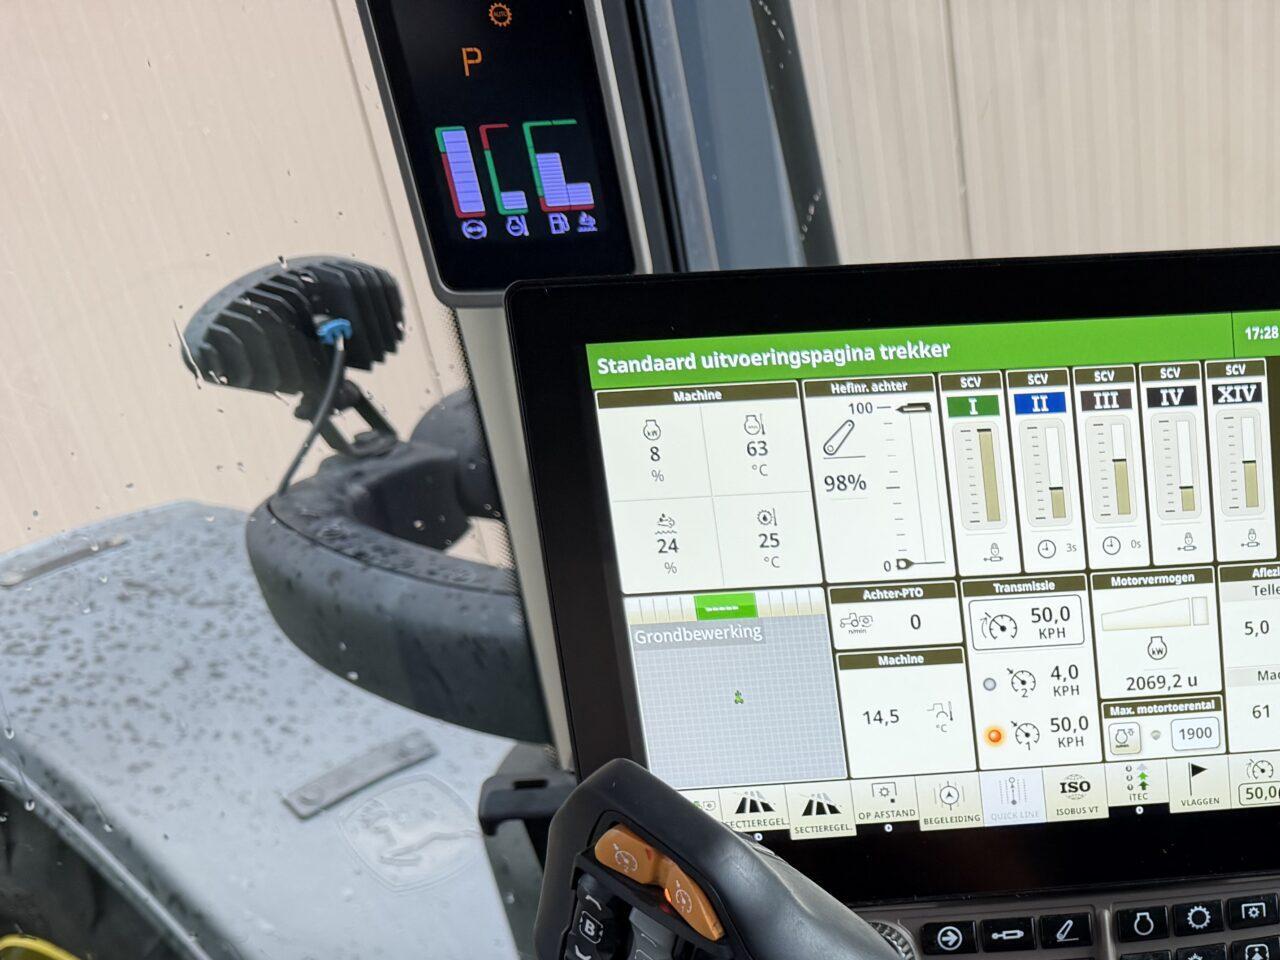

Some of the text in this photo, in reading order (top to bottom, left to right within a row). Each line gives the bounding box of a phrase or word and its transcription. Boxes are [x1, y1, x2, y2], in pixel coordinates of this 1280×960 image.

[461, 47, 483, 77] P
[1245, 325, 1279, 340] 17:28
[597, 340, 951, 375] Standaard uitvoeringspagina trekker
[1094, 370, 1115, 382] SCV
[1160, 367, 1181, 379] SCV
[1225, 364, 1246, 376] SCV
[960, 377, 981, 389] SCV
[1027, 373, 1048, 385] SCV
[830, 379, 908, 394] Hefinr. achter
[1217, 384, 1257, 403] XIV
[673, 388, 723, 402] Machine
[1093, 391, 1120, 409] III
[1160, 388, 1185, 406] IV
[848, 402, 873, 415] 100
[968, 398, 979, 416] I
[1031, 395, 1048, 412] II
[649, 447, 661, 462] 8
[746, 440, 769, 456] 63
[651, 469, 665, 483] %
[823, 474, 867, 492] 98%
[657, 538, 680, 554] 24
[758, 533, 780, 549] 25
[1066, 543, 1077, 553] 3s
[1131, 539, 1142, 549] 0s
[664, 562, 678, 574] %
[883, 560, 892, 573] 0
[993, 579, 1056, 593] Transmissie
[1111, 572, 1195, 587] Motorvermogen
[862, 588, 924, 601] Achter-PTO
[910, 614, 922, 630] 0
[1030, 606, 1071, 625] 50,0
[634, 624, 764, 644] Grondbewerking
[1038, 627, 1067, 640] KPH
[1244, 619, 1271, 638] 5,0
[877, 653, 924, 667] Machine
[1050, 664, 1079, 683] 4,0
[1126, 674, 1198, 692] 2069,2 u
[1021, 688, 1029, 698] 2
[1053, 684, 1080, 698] KPH
[1110, 699, 1216, 717] Max. motortoerental
[1252, 704, 1271, 719] 61
[862, 709, 900, 727] 14,5
[1050, 715, 1089, 735] 50,0
[1178, 726, 1213, 741] 1900
[1025, 741, 1031, 751] 1
[1057, 736, 1085, 749] KPH
[1059, 781, 1092, 794] ISO
[1245, 785, 1277, 802] 50,0
[1181, 797, 1220, 808] VLAGGEN
[858, 808, 916, 821] OP AFSTAND
[991, 811, 1016, 822] QUICK
[1056, 805, 1100, 817] ISOBUS VT
[726, 817, 790, 830] ECTIEREGEL.
[923, 814, 981, 826] BEGELEIDING
[794, 824, 853, 835] SECTIEREGEL.
[584, 922, 596, 936] B
